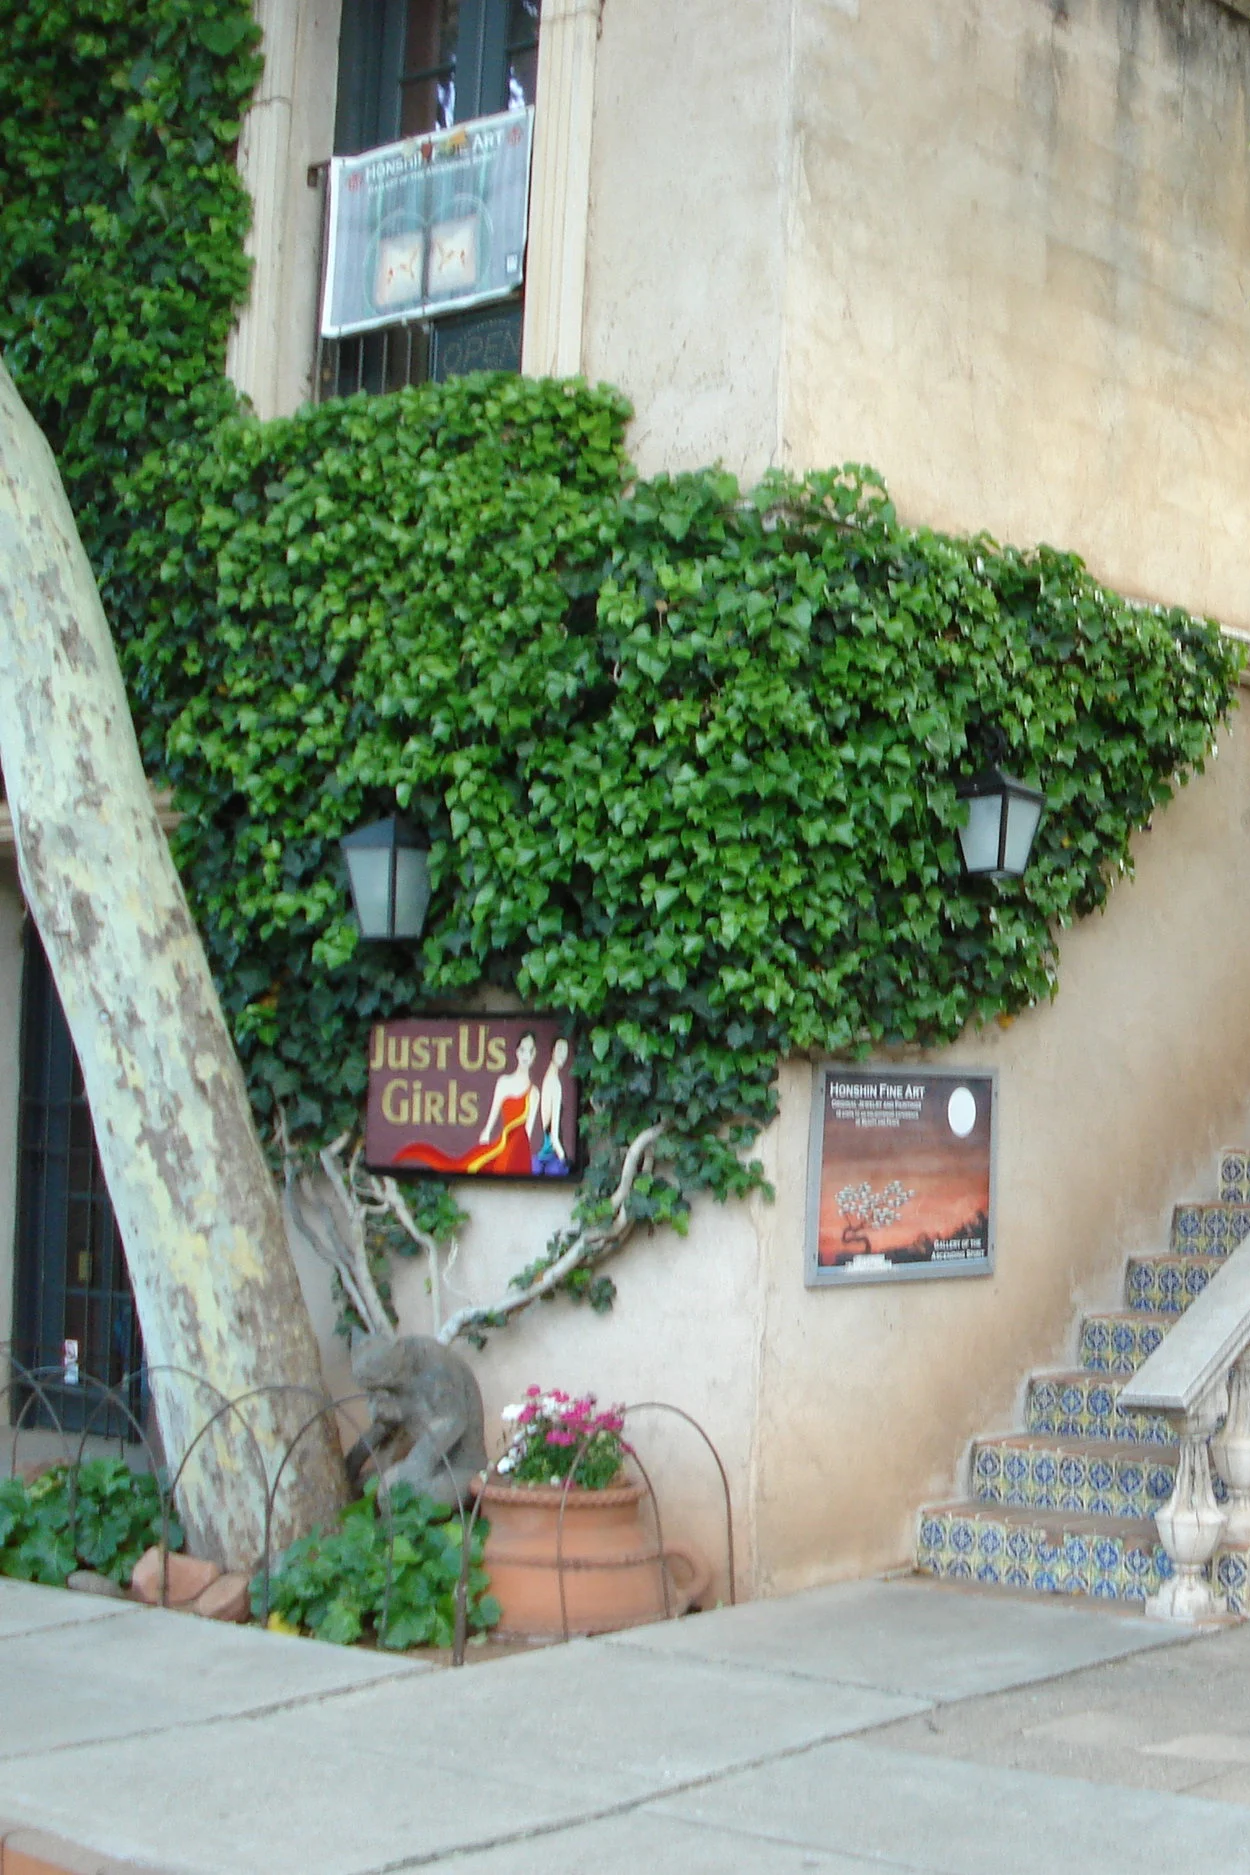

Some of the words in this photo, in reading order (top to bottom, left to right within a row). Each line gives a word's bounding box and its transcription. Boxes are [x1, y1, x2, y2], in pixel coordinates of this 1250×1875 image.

[829, 1081, 878, 1099] HONSHIN
[879, 1082, 903, 1100] FINE
[904, 1083, 926, 1101] ART
